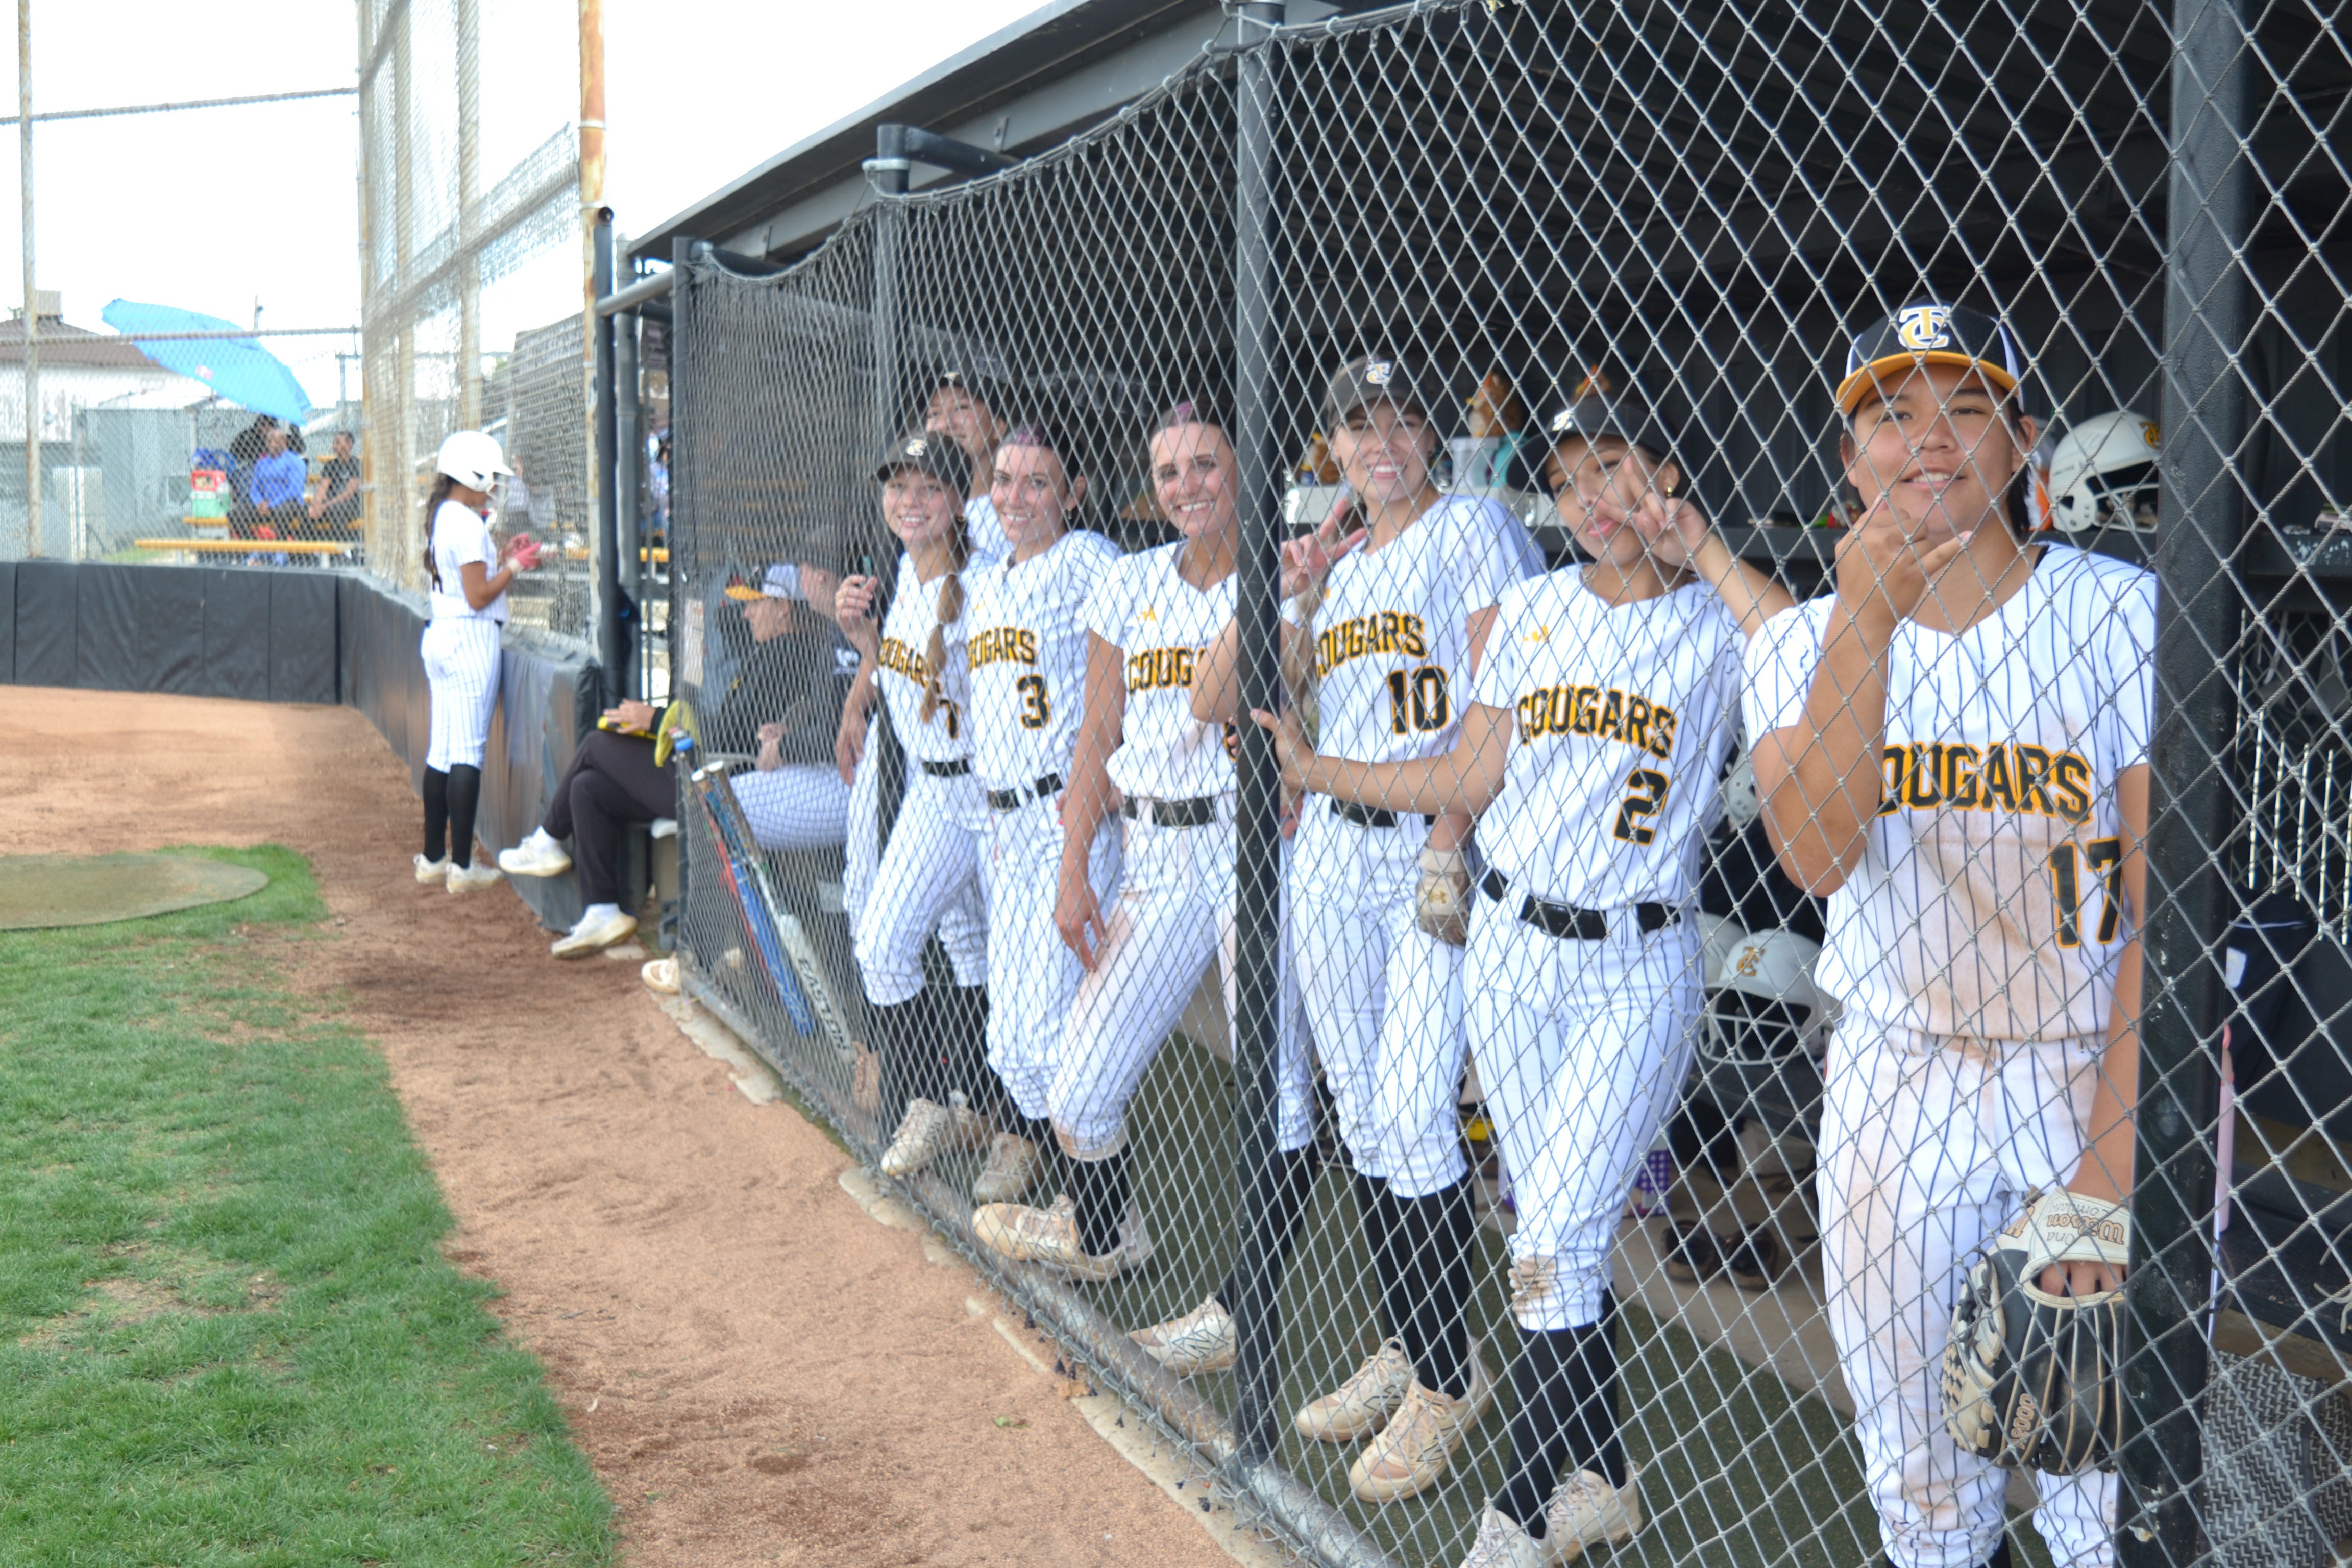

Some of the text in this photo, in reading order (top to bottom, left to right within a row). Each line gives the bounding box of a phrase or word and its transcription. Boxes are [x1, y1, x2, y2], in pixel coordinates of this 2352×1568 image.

[967, 626, 1039, 676] OUGARS
[1127, 647, 1207, 696] COUG
[1315, 610, 1428, 687] OUGARS
[1016, 673, 1050, 729] 3
[1387, 665, 1450, 736] 10
[1516, 683, 1678, 761] COUGARS
[1612, 768, 1671, 847] 2
[1877, 741, 2094, 826] OUGARS
[2047, 836, 2123, 949] 17
[2046, 1213, 2124, 1245] Wilson
